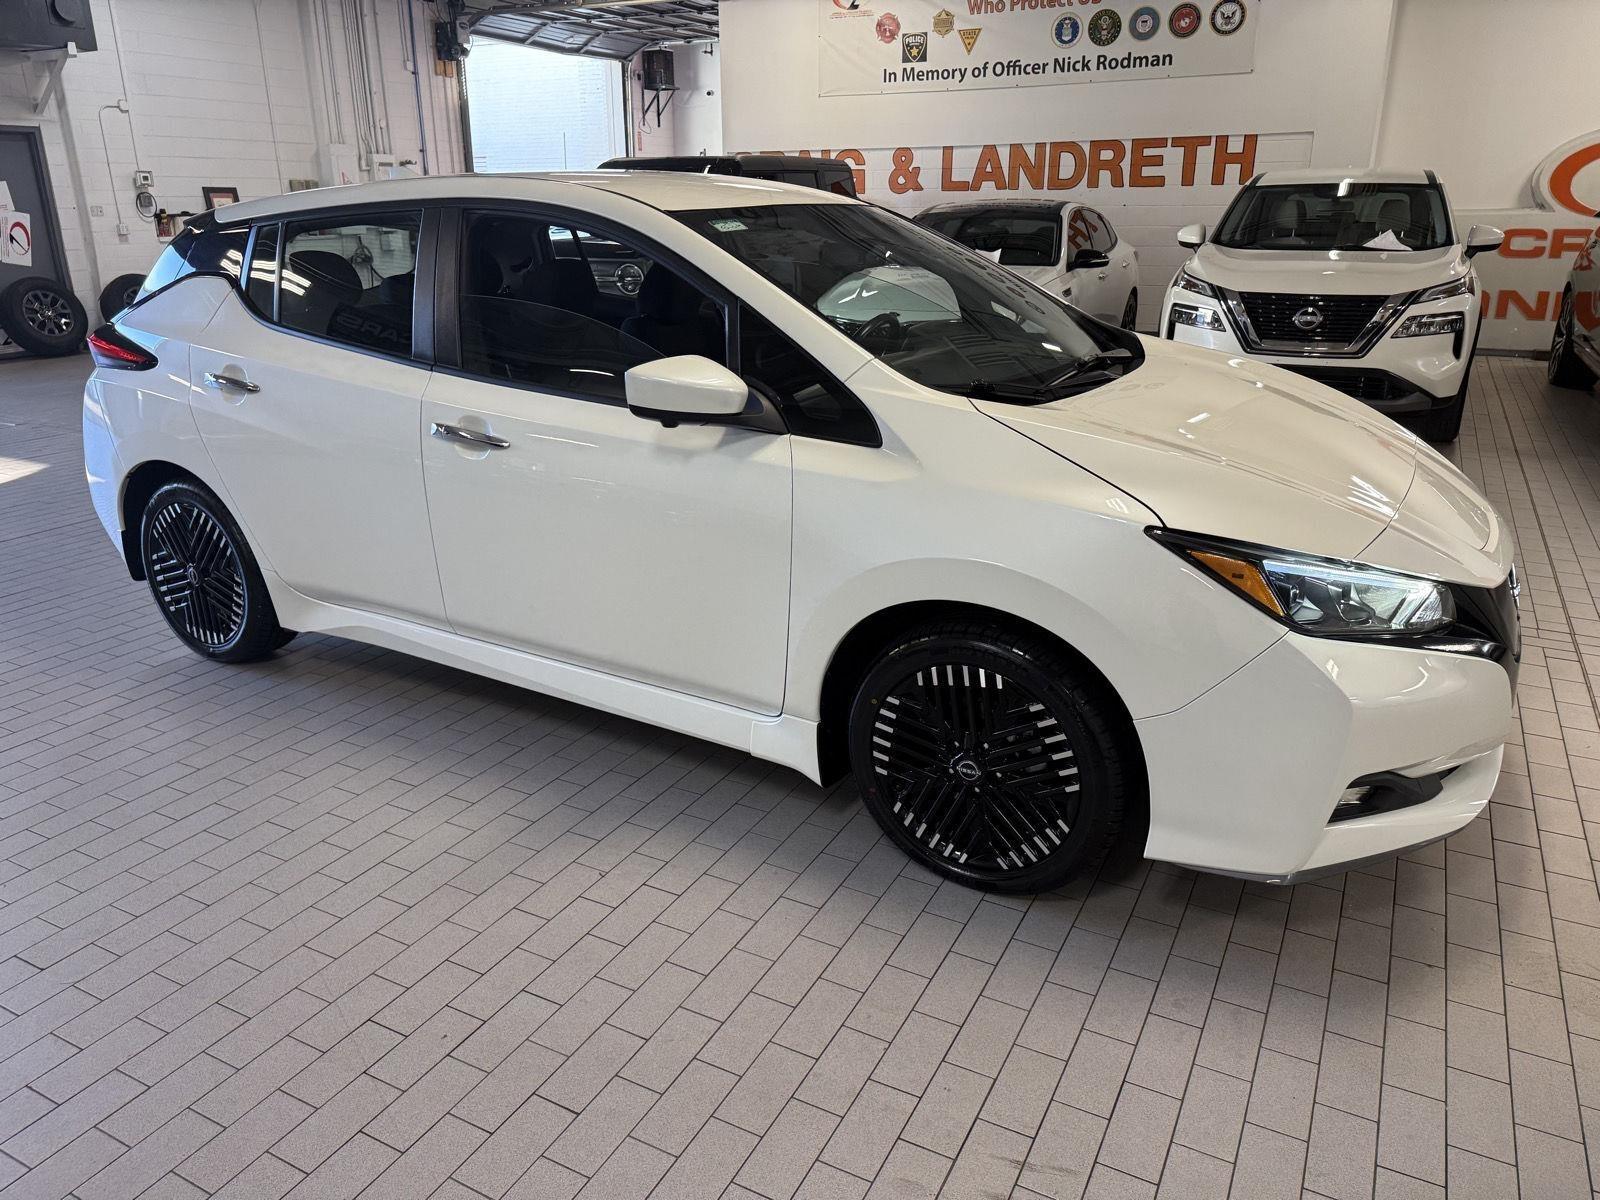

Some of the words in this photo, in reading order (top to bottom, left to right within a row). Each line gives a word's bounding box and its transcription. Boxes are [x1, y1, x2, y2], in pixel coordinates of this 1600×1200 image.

[967, 0, 1005, 15] Who
[905, 35, 924, 45] POLICE
[883, 68, 897, 83] In
[902, 66, 968, 83] Memory
[971, 61, 989, 78] of
[992, 59, 1048, 77] Officer
[1053, 55, 1091, 73] Nick
[1096, 52, 1173, 71] Rodman
[888, 147, 924, 194] &
[941, 134, 1258, 191] LANDRETH
